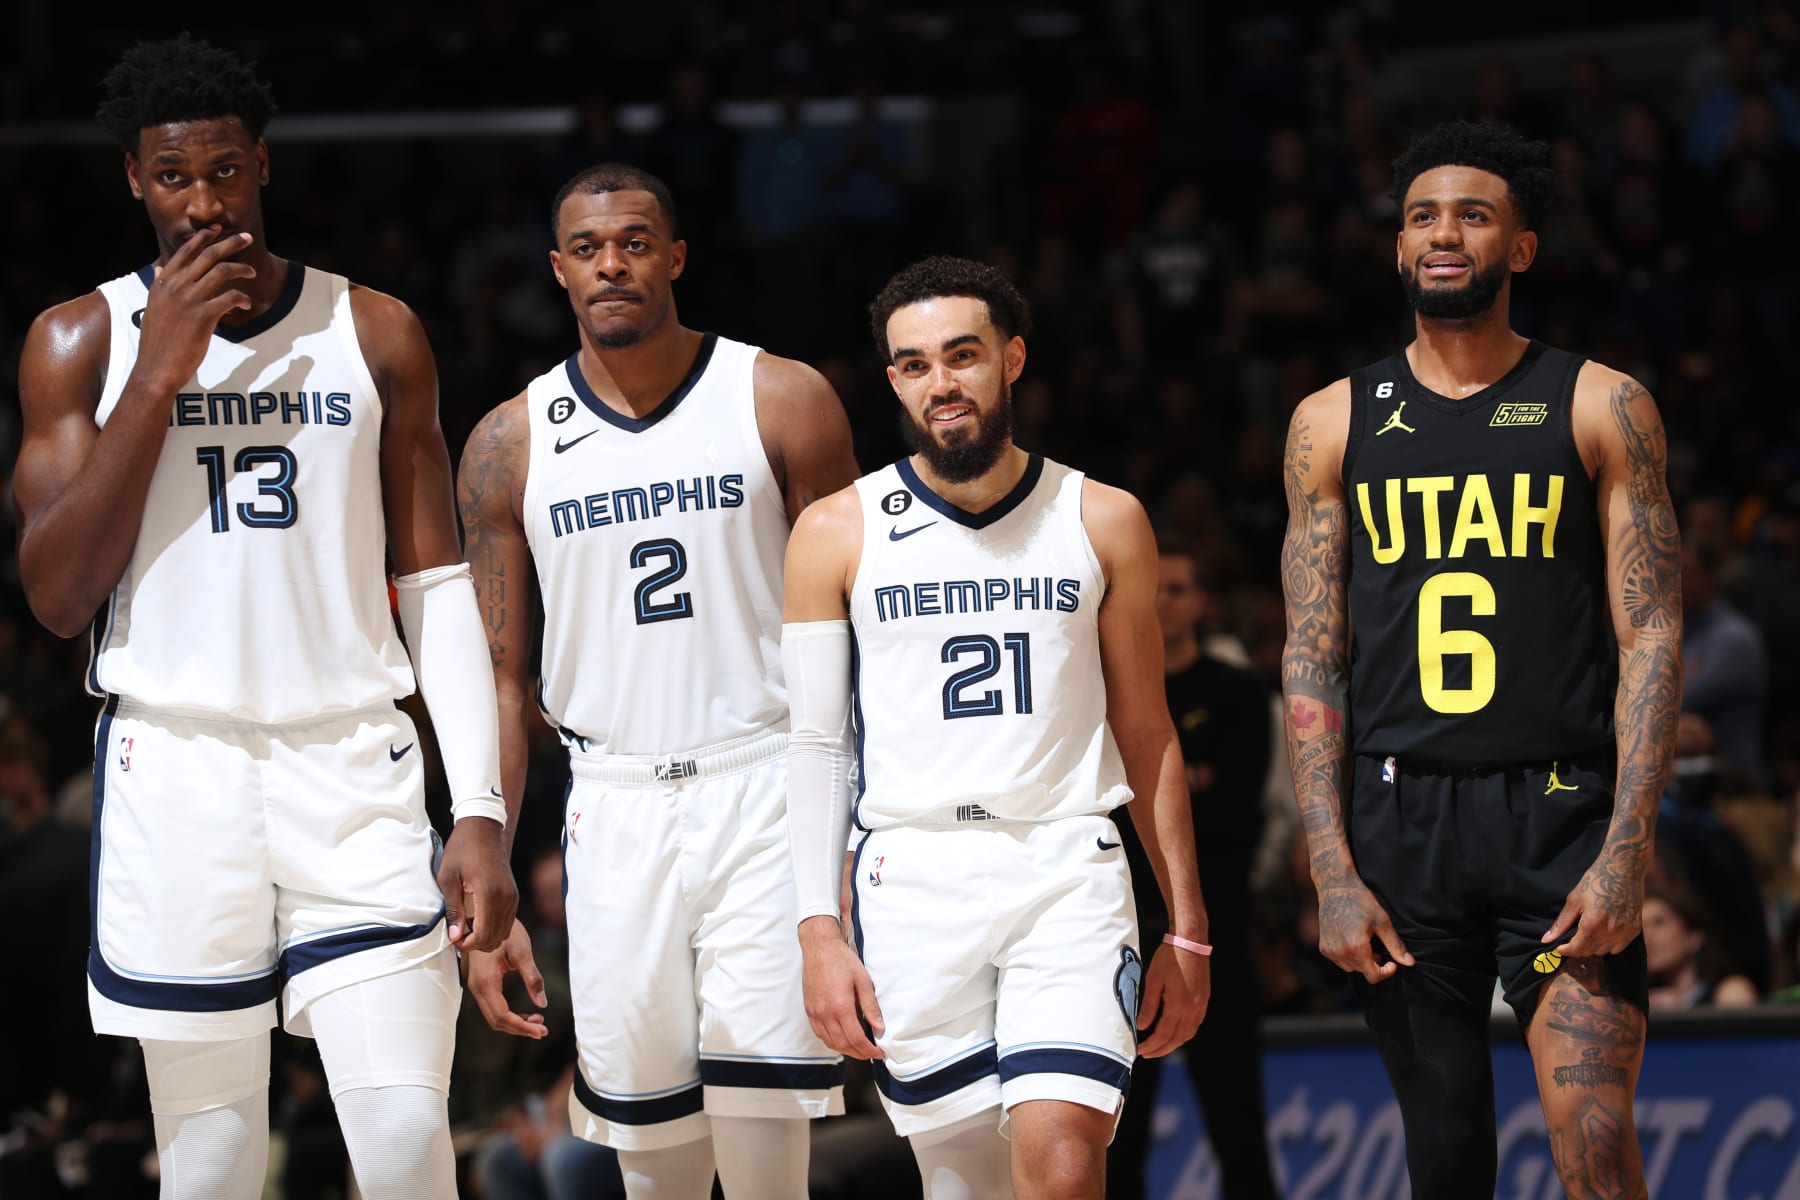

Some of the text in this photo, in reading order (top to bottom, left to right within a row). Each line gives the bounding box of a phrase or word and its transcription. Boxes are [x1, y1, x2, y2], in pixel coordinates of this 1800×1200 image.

[168, 391, 352, 426] EMPHIS
[553, 400, 569, 421] 6
[1375, 381, 1394, 398] 6
[1496, 406, 1513, 423] 5
[1511, 414, 1542, 422] FIGHT
[196, 445, 298, 533] 13
[549, 474, 744, 538] MEMPHIS
[888, 494, 905, 512] 6
[1356, 473, 1565, 565] UTAH
[630, 537, 694, 625] 2
[874, 577, 1081, 623] MEMPHIS
[1418, 572, 1497, 714] 6
[941, 632, 1033, 722] 21
